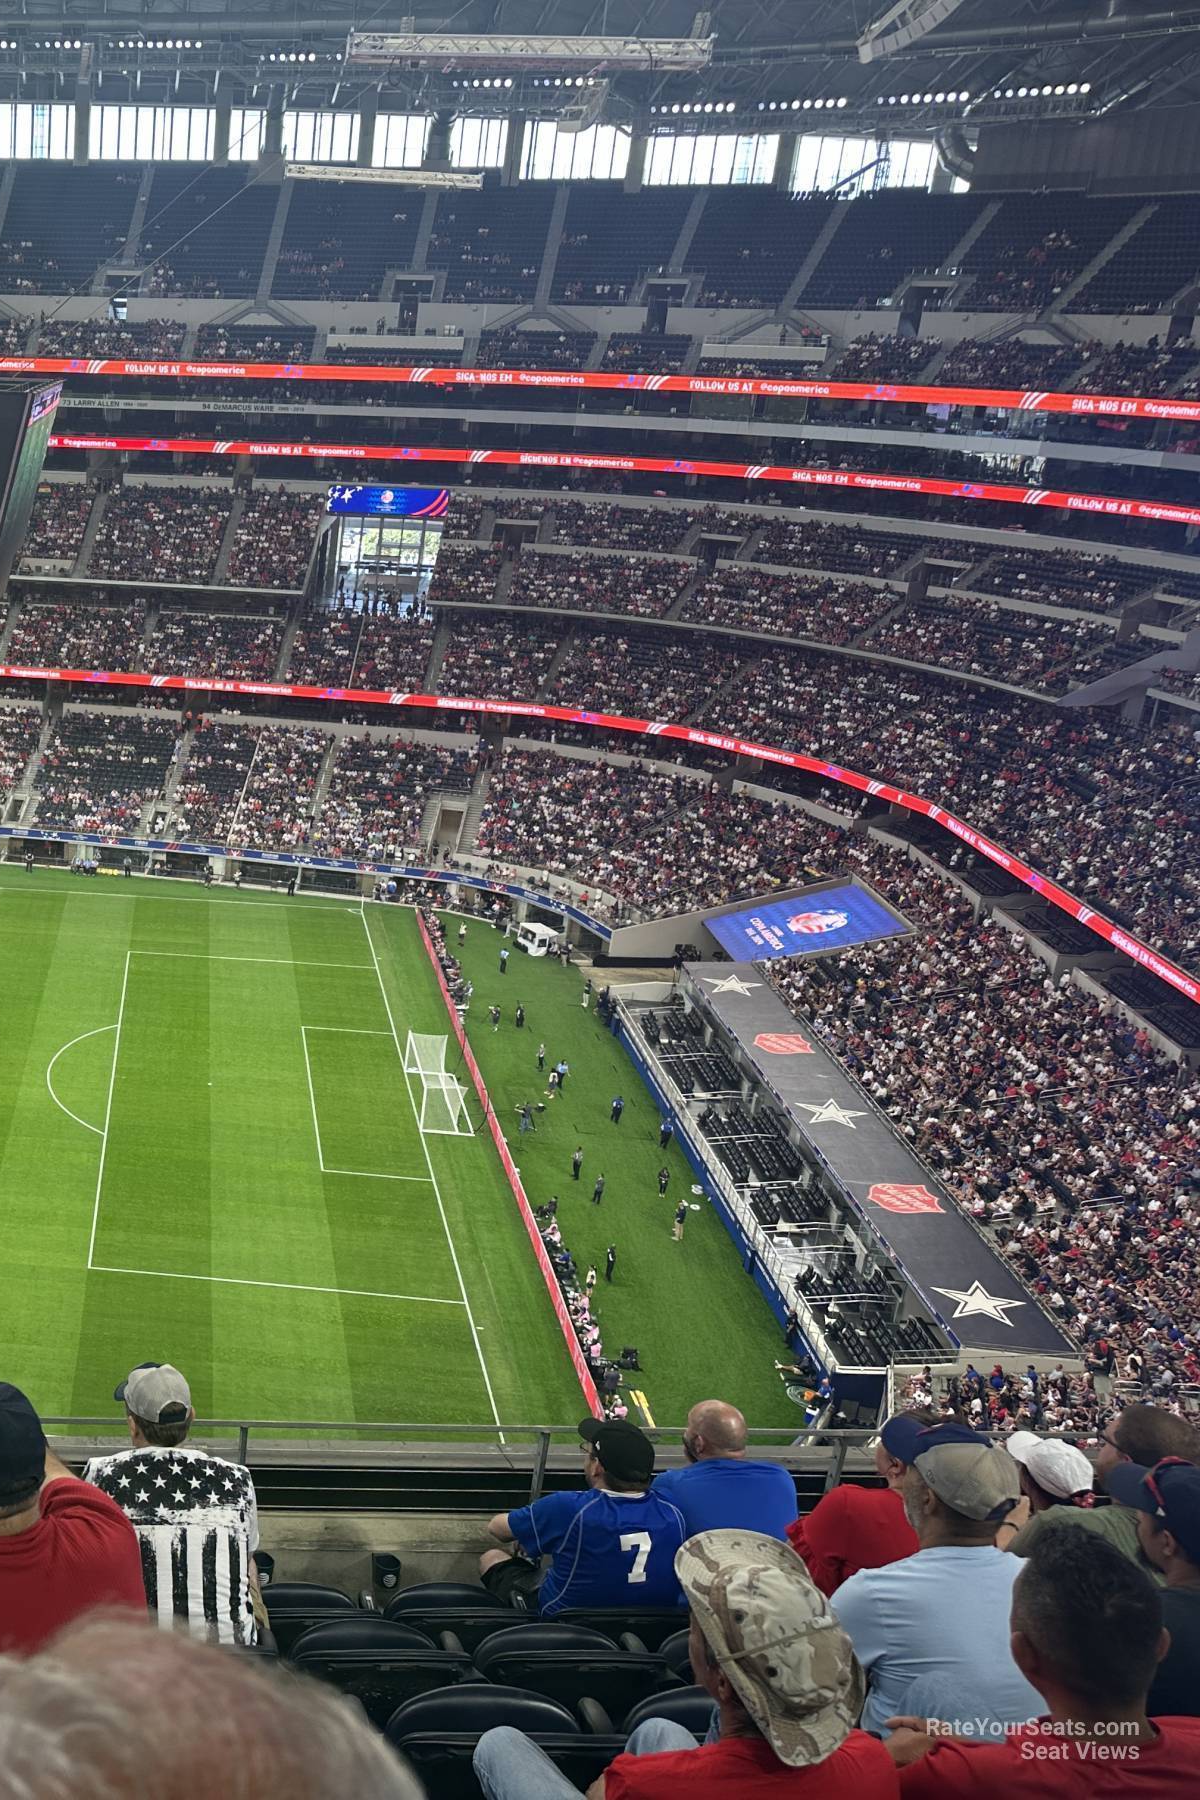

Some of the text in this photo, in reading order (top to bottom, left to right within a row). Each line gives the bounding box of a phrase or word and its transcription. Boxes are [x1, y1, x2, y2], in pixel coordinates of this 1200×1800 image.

[125, 364, 157, 373] FOLLOW
[159, 365, 169, 374] US
[171, 365, 181, 374] AT
[690, 380, 726, 390] FOLLOW
[728, 382, 740, 391] US
[742, 382, 754, 391] AT
[1121, 402, 1137, 412] EM
[249, 445, 279, 453] FOLLOW
[293, 446, 303, 454] AT
[1067, 497, 1103, 509] FOLLOW
[1106, 500, 1118, 511] US
[1119, 502, 1132, 512] AT
[619, 1531, 652, 1584] 7
